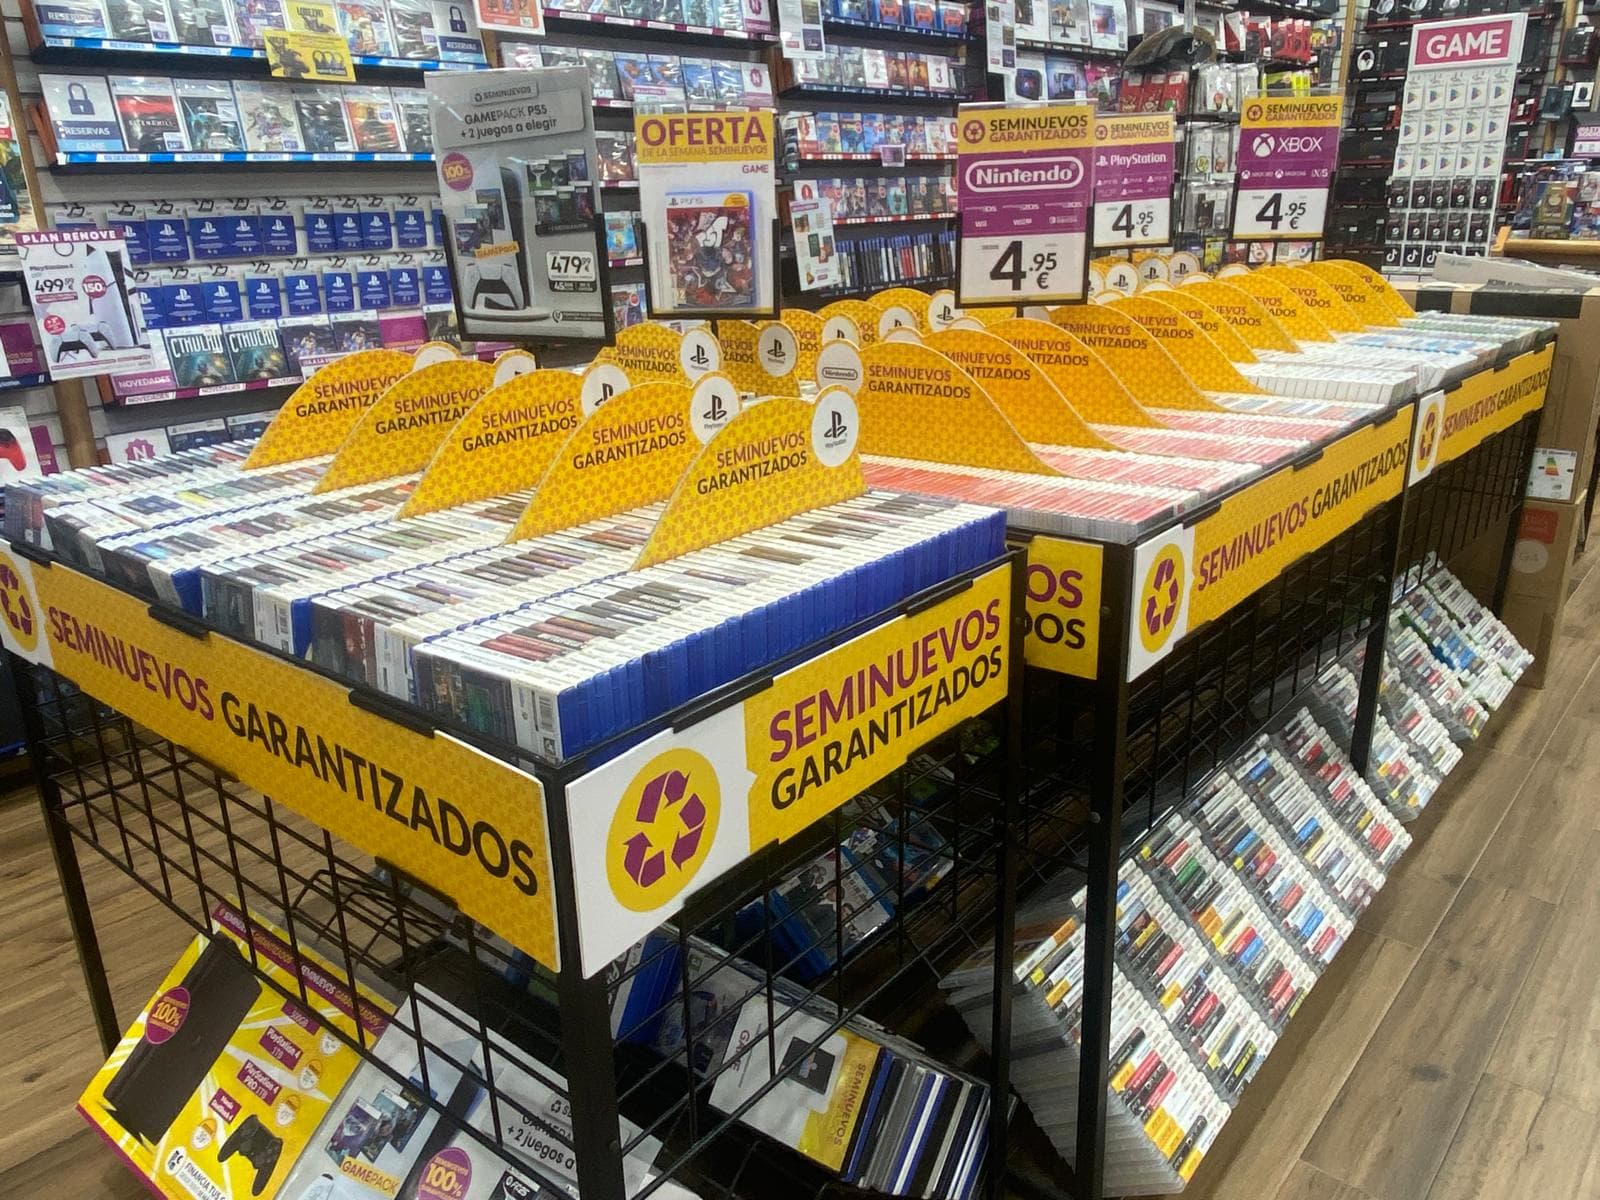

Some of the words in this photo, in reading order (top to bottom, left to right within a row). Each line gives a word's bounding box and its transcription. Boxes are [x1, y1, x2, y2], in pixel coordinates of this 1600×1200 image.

[1426, 28, 1504, 59] GAME
[936, 68, 943, 84] 3
[464, 107, 526, 125] GAMEPACK
[527, 104, 548, 116] PS5
[1265, 112, 1337, 121] GARANTIZADOS
[1266, 103, 1338, 114] SEMINUEVOS
[64, 127, 111, 136] RESERVAS
[469, 128, 477, 138] 2
[477, 123, 513, 140] juegos
[515, 123, 524, 132] a
[525, 117, 558, 131] elegir
[641, 116, 768, 147] OFERTA
[989, 128, 1088, 143] GARANTIZADOS
[990, 115, 1088, 132] SEMINUEVOS
[1110, 121, 1170, 132] SEMINUEVOS
[1110, 130, 1169, 140] GARANTIZADOS
[642, 148, 655, 158] DE
[656, 148, 668, 158] LA
[670, 146, 707, 157] SEMANA
[708, 144, 768, 156] SEMINUEVOS
[1277, 136, 1323, 153] XBOX
[742, 164, 769, 174] GAME
[1110, 152, 1167, 168] PlayStation
[975, 164, 1073, 185] Nintendo
[22, 232, 61, 244] PLAN
[63, 229, 116, 242] RENOVE
[551, 255, 583, 274] 479
[35, 278, 64, 293] 499
[171, 333, 224, 358] CTHULHU
[230, 329, 279, 353] CTHULHU
[118, 376, 172, 388] NOVEDADES
[868, 365, 951, 382] SEMINUEVOS
[394, 386, 486, 415] SEMINUEVOS
[868, 380, 971, 399] GARANTIZADOS
[296, 391, 383, 418] GARANTIZA
[481, 398, 575, 430] SEMINUEVOS
[1442, 393, 1497, 441] SEMINUEVOS
[1497, 368, 1550, 411] GARANTIZADOS
[375, 406, 470, 435] GARANTIZAD
[462, 415, 578, 452] GARANTIZADOS
[592, 412, 684, 447] SEMINUEVOS
[573, 431, 687, 470] GARANTIZADOS
[717, 430, 806, 470] SEMINUEVOS
[697, 450, 808, 496] GARANTIZADOS
[1198, 496, 1310, 592] SEMINUEVOS
[1312, 438, 1409, 519] GARANTIZADOS
[768, 598, 1003, 763] SEMINUEVOS
[769, 644, 1003, 811] GARANTIZADOS
[48, 605, 216, 722] SEMINUEVOS
[220, 691, 540, 897] GARANTIZADOS
[153, 1001, 184, 1027] 100%
[265, 1028, 296, 1056] PlayStation
[294, 1048, 302, 1060] 4
[244, 1062, 275, 1090] PlayStation
[834, 1062, 867, 1146] SEMINUEVOS
[514, 1128, 525, 1142] 2
[520, 1132, 564, 1165] juegos
[565, 1157, 576, 1170] a
[184, 1162, 209, 1190] FINANCIA
[342, 1160, 400, 1195] GAMEPACK
[426, 1163, 464, 1197] 100%
